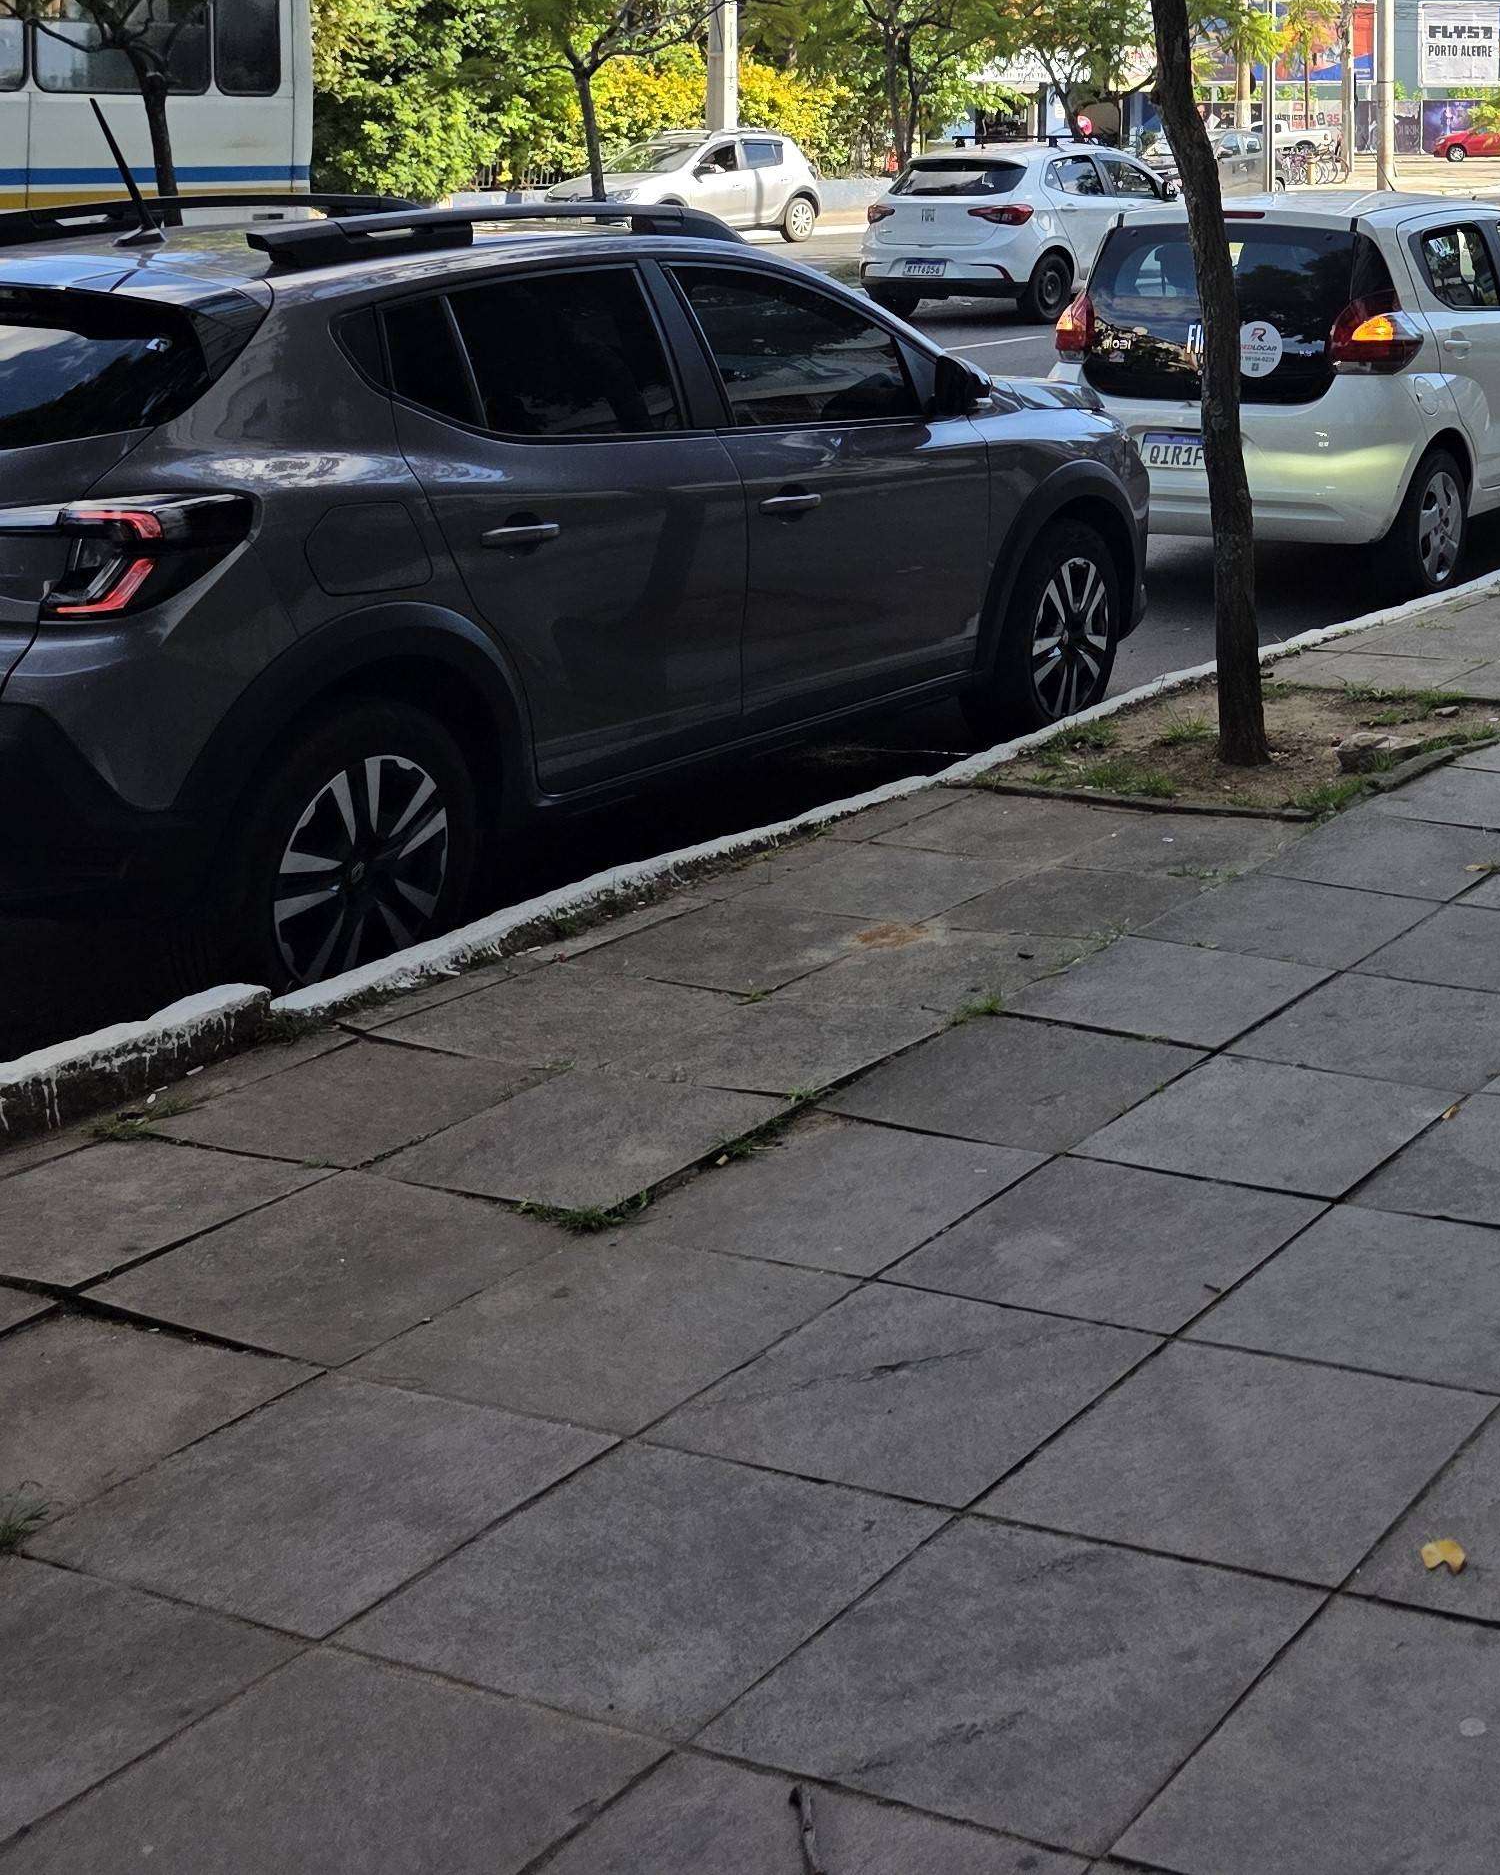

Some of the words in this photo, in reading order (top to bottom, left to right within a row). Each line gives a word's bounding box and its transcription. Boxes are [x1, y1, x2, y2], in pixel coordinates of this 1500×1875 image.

[1428, 44, 1458, 57] PORTO
[1186, 324, 1204, 354] FI
[1149, 445, 1204, 466] QIR1F
